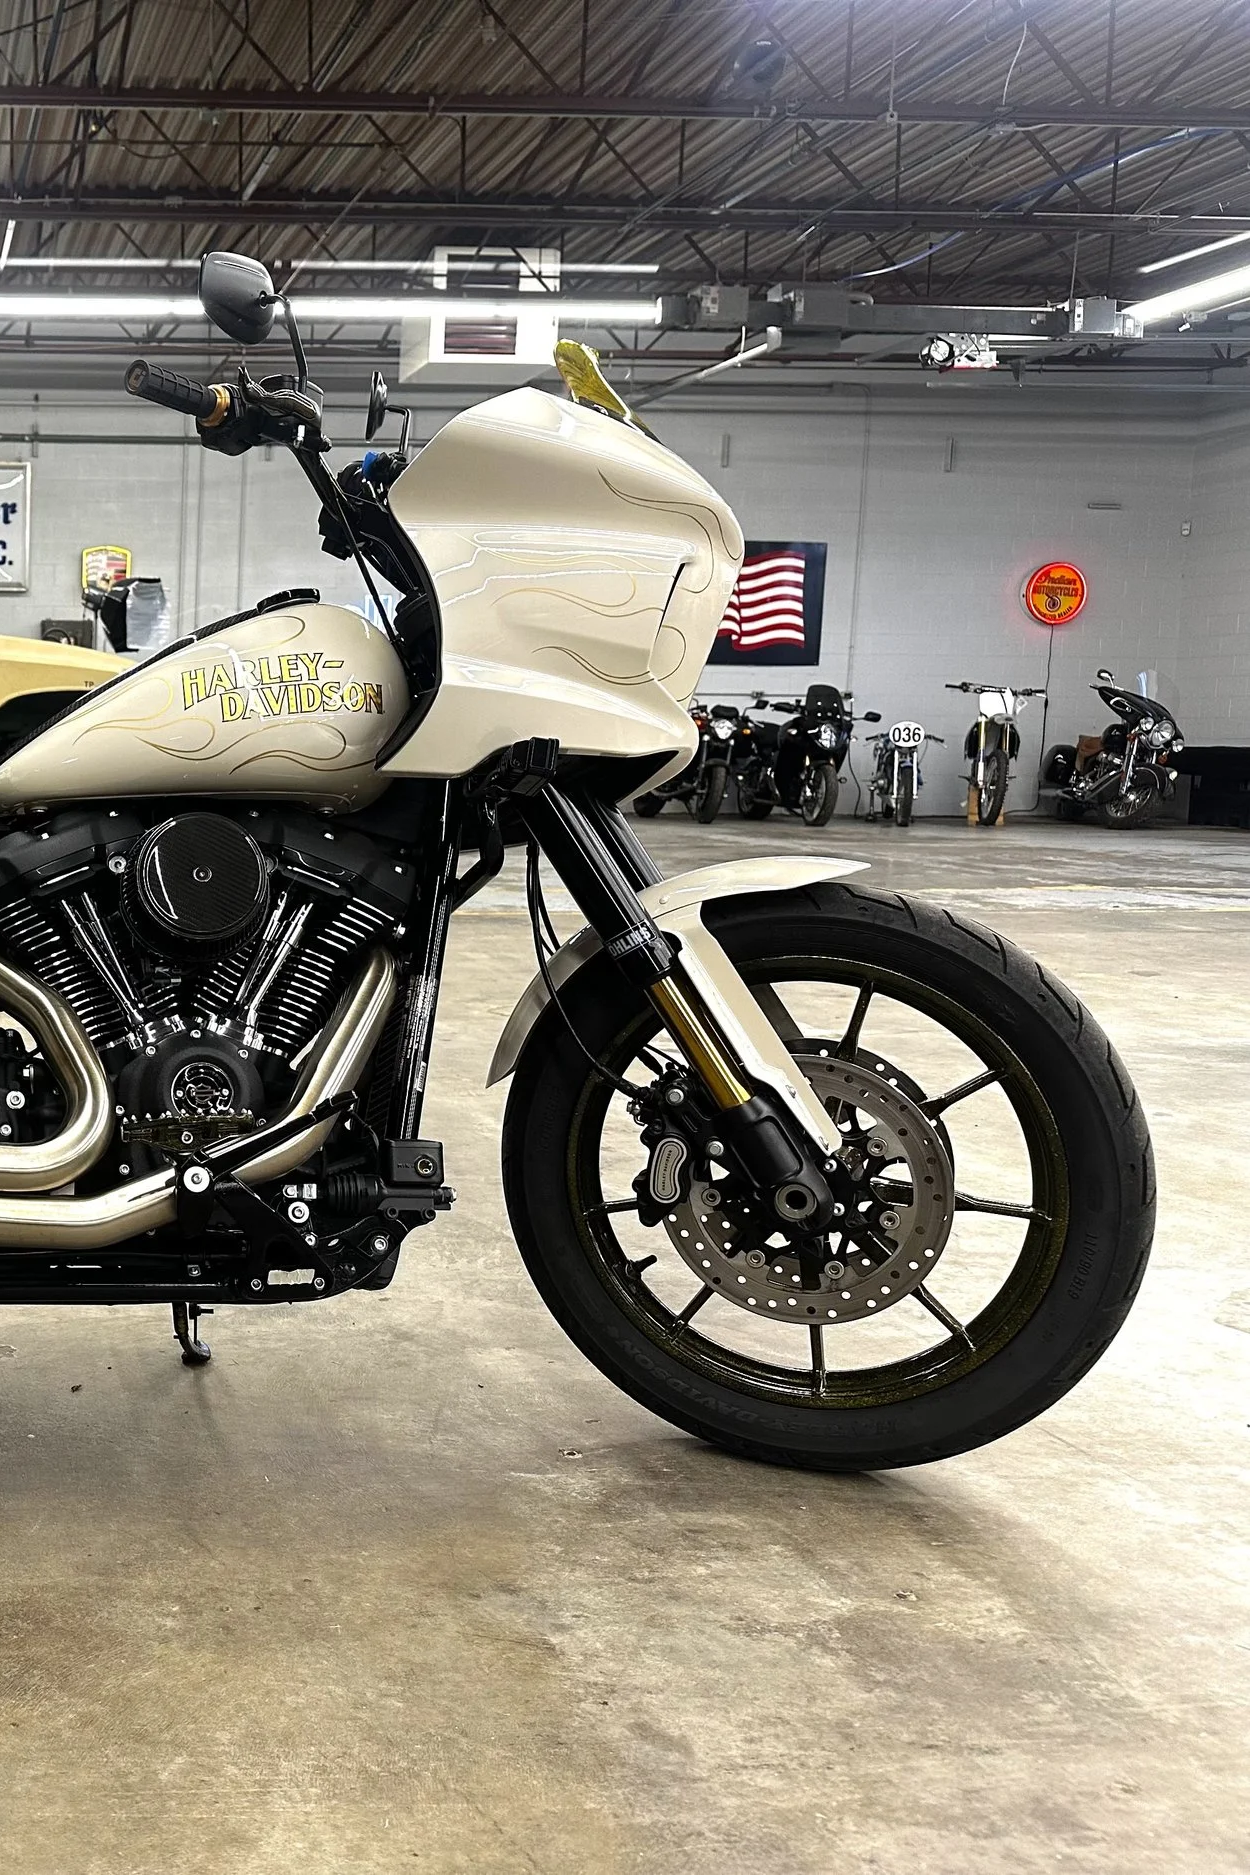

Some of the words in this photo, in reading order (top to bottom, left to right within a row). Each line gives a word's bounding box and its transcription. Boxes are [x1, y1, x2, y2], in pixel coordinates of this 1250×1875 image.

[181, 652, 345, 711] HARLEY-
[219, 681, 385, 723] DAVIDSON
[892, 727, 921, 743] 036
